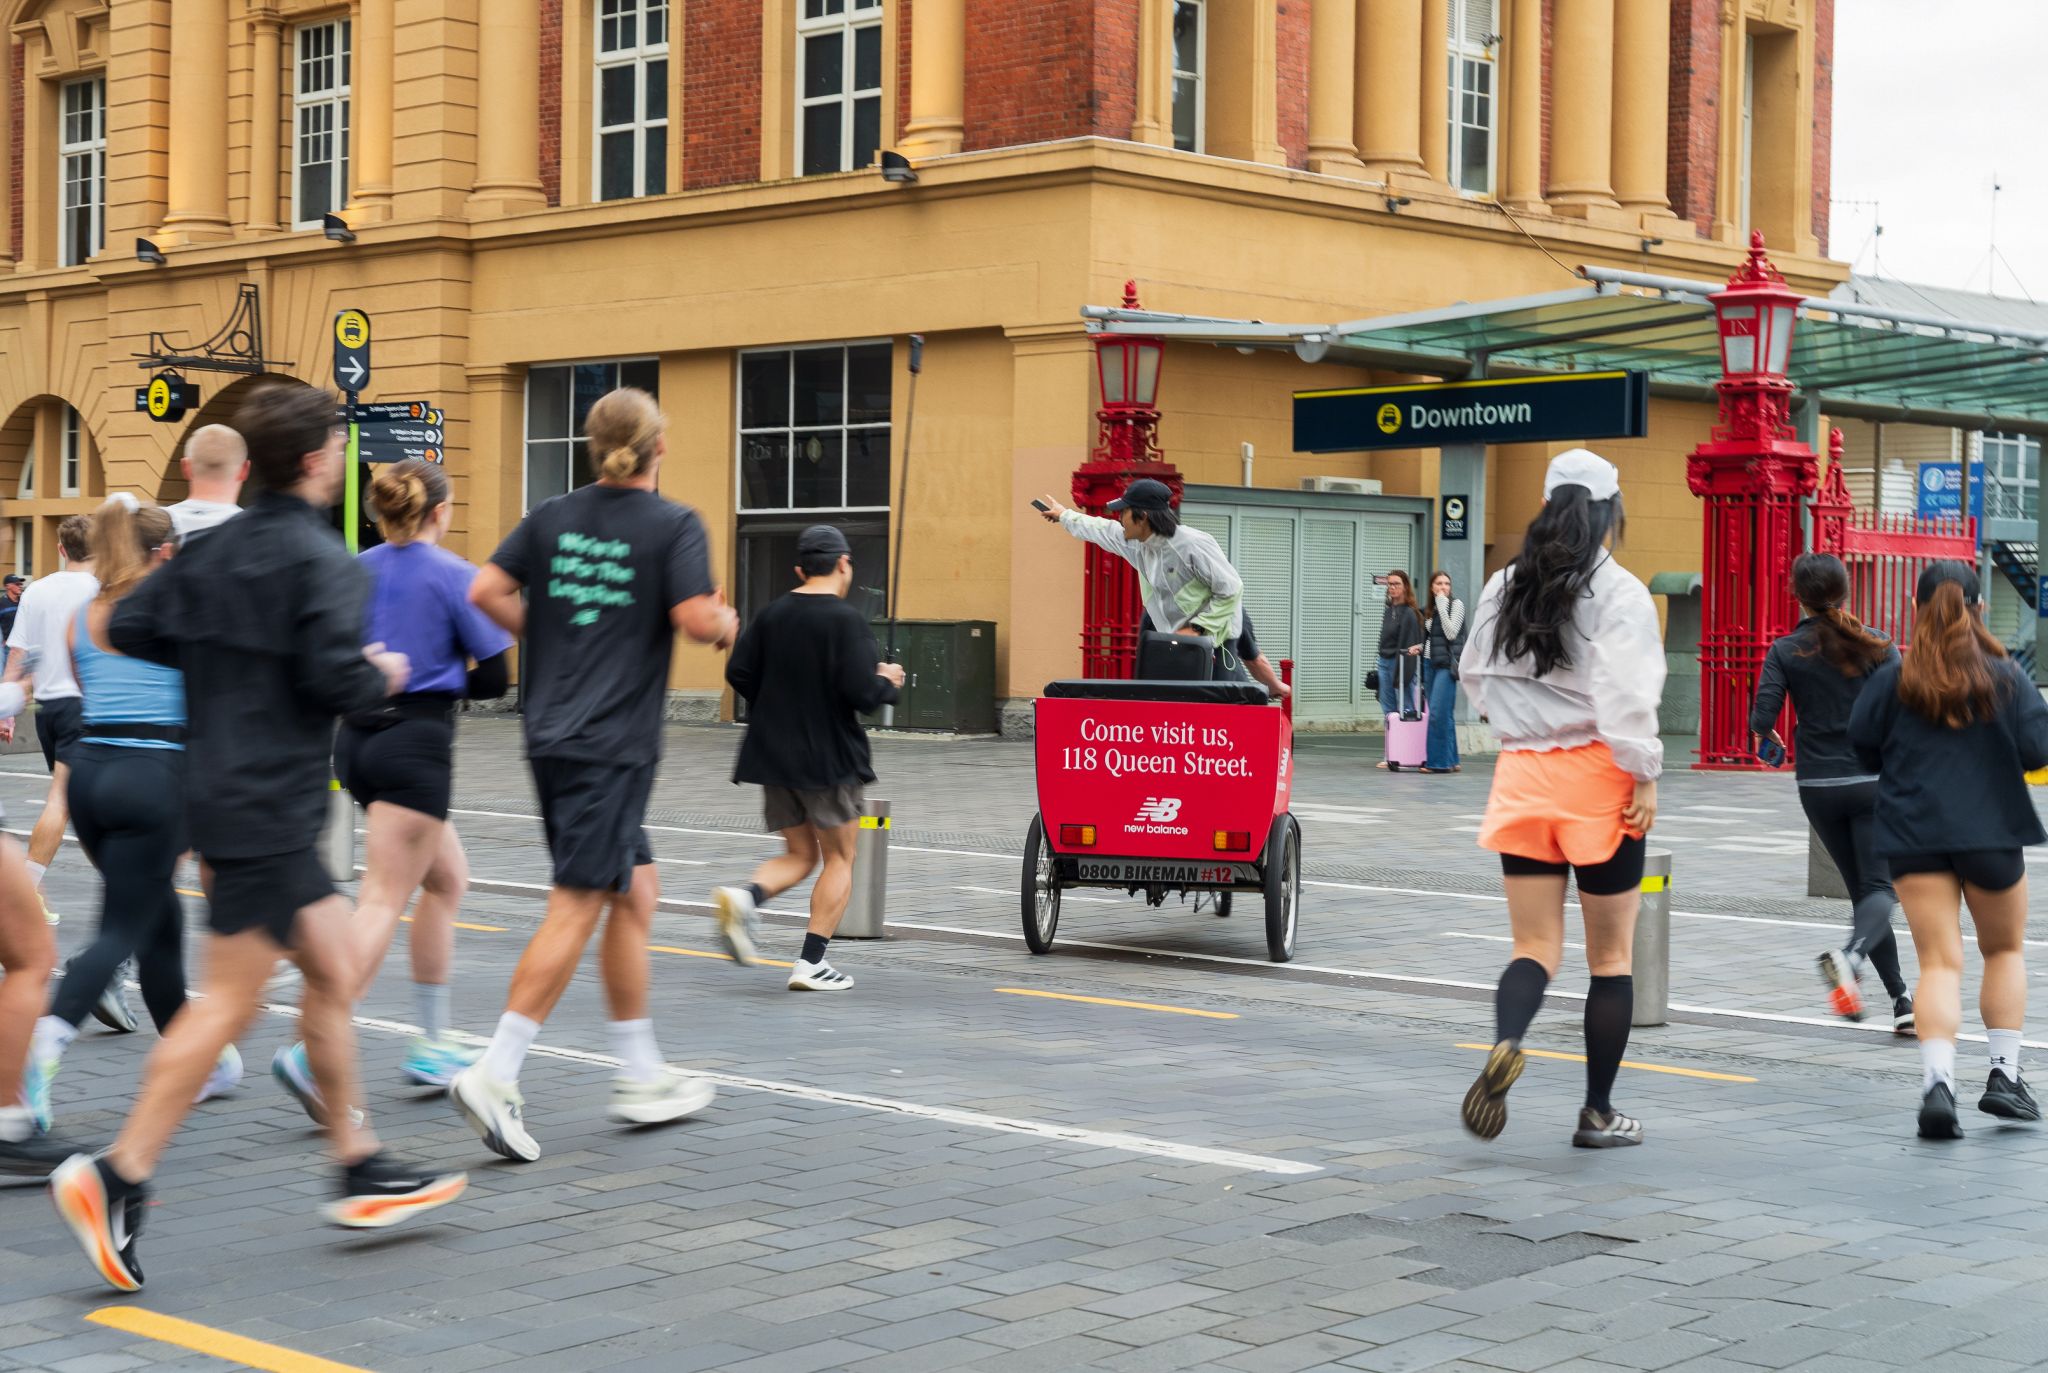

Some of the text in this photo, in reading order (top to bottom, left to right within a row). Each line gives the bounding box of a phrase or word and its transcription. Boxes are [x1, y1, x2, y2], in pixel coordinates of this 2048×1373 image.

[1410, 402, 1532, 430] Downtown
[1080, 718, 1235, 752] Come visit us,
[1062, 747, 1098, 771] 118
[1104, 748, 1177, 778] Queen
[1183, 751, 1253, 777] Street.
[1124, 824, 1189, 836] new balance
[1079, 864, 1232, 883] 0800 BIKEMAN #12
